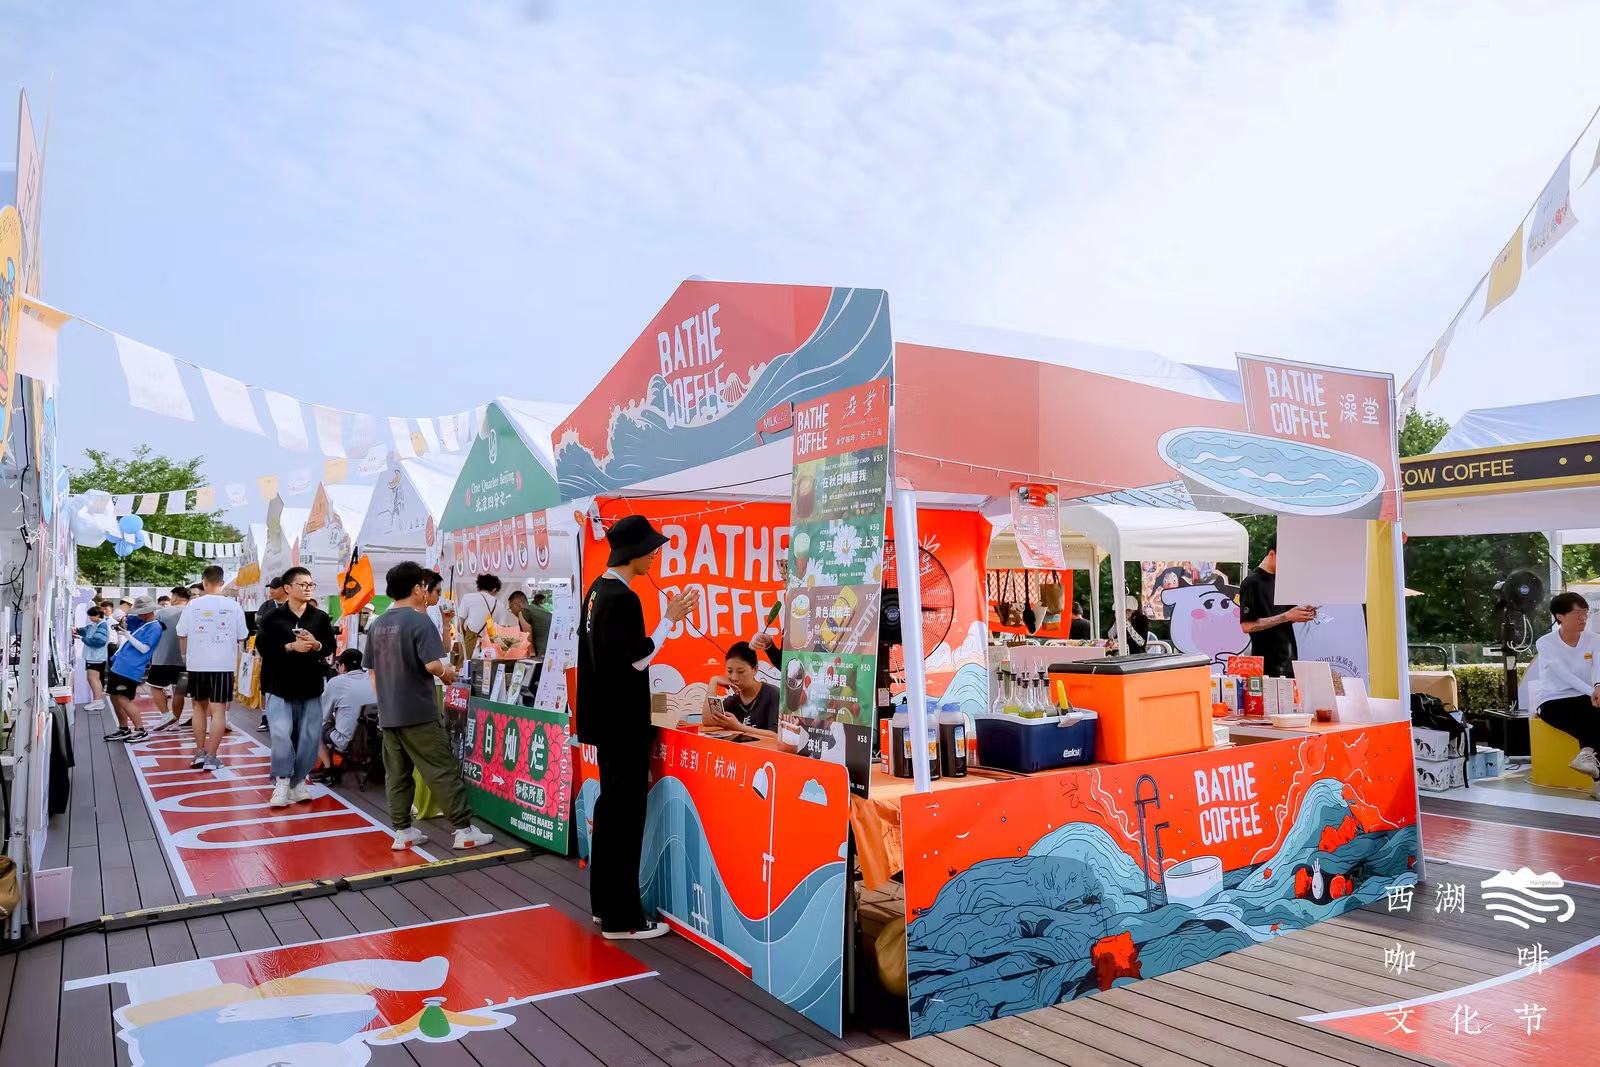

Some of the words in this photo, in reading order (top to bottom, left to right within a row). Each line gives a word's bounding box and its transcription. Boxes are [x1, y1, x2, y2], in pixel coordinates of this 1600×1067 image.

[657, 303, 723, 378] BATHE
[662, 361, 728, 430] COFFEE
[1264, 366, 1326, 407] BATHE
[796, 402, 829, 433] BATHE
[1270, 401, 1331, 440] COFFEE
[1339, 393, 1380, 425] 澡堂
[796, 428, 828, 456] COFFEE
[471, 482, 481, 494] One
[481, 477, 499, 493] Quarter
[499, 471, 515, 485] Beijing
[1442, 458, 1514, 482] COFFEE
[475, 491, 512, 512] 北京四分之一
[860, 663, 871, 672] ¥50
[561, 723, 571, 756] ONE
[856, 735, 868, 744] ¥58
[515, 783, 545, 805] 如你所愿
[557, 757, 569, 832] QUARTER
[1194, 761, 1256, 807] BATHE
[510, 816, 518, 827] ONE
[517, 818, 537, 836] QUARTER
[537, 824, 543, 837] OF
[543, 827, 554, 841] LIFE
[522, 811, 537, 825] COFFEE
[537, 816, 554, 830] MAKES
[1199, 802, 1263, 847] COFFEE
